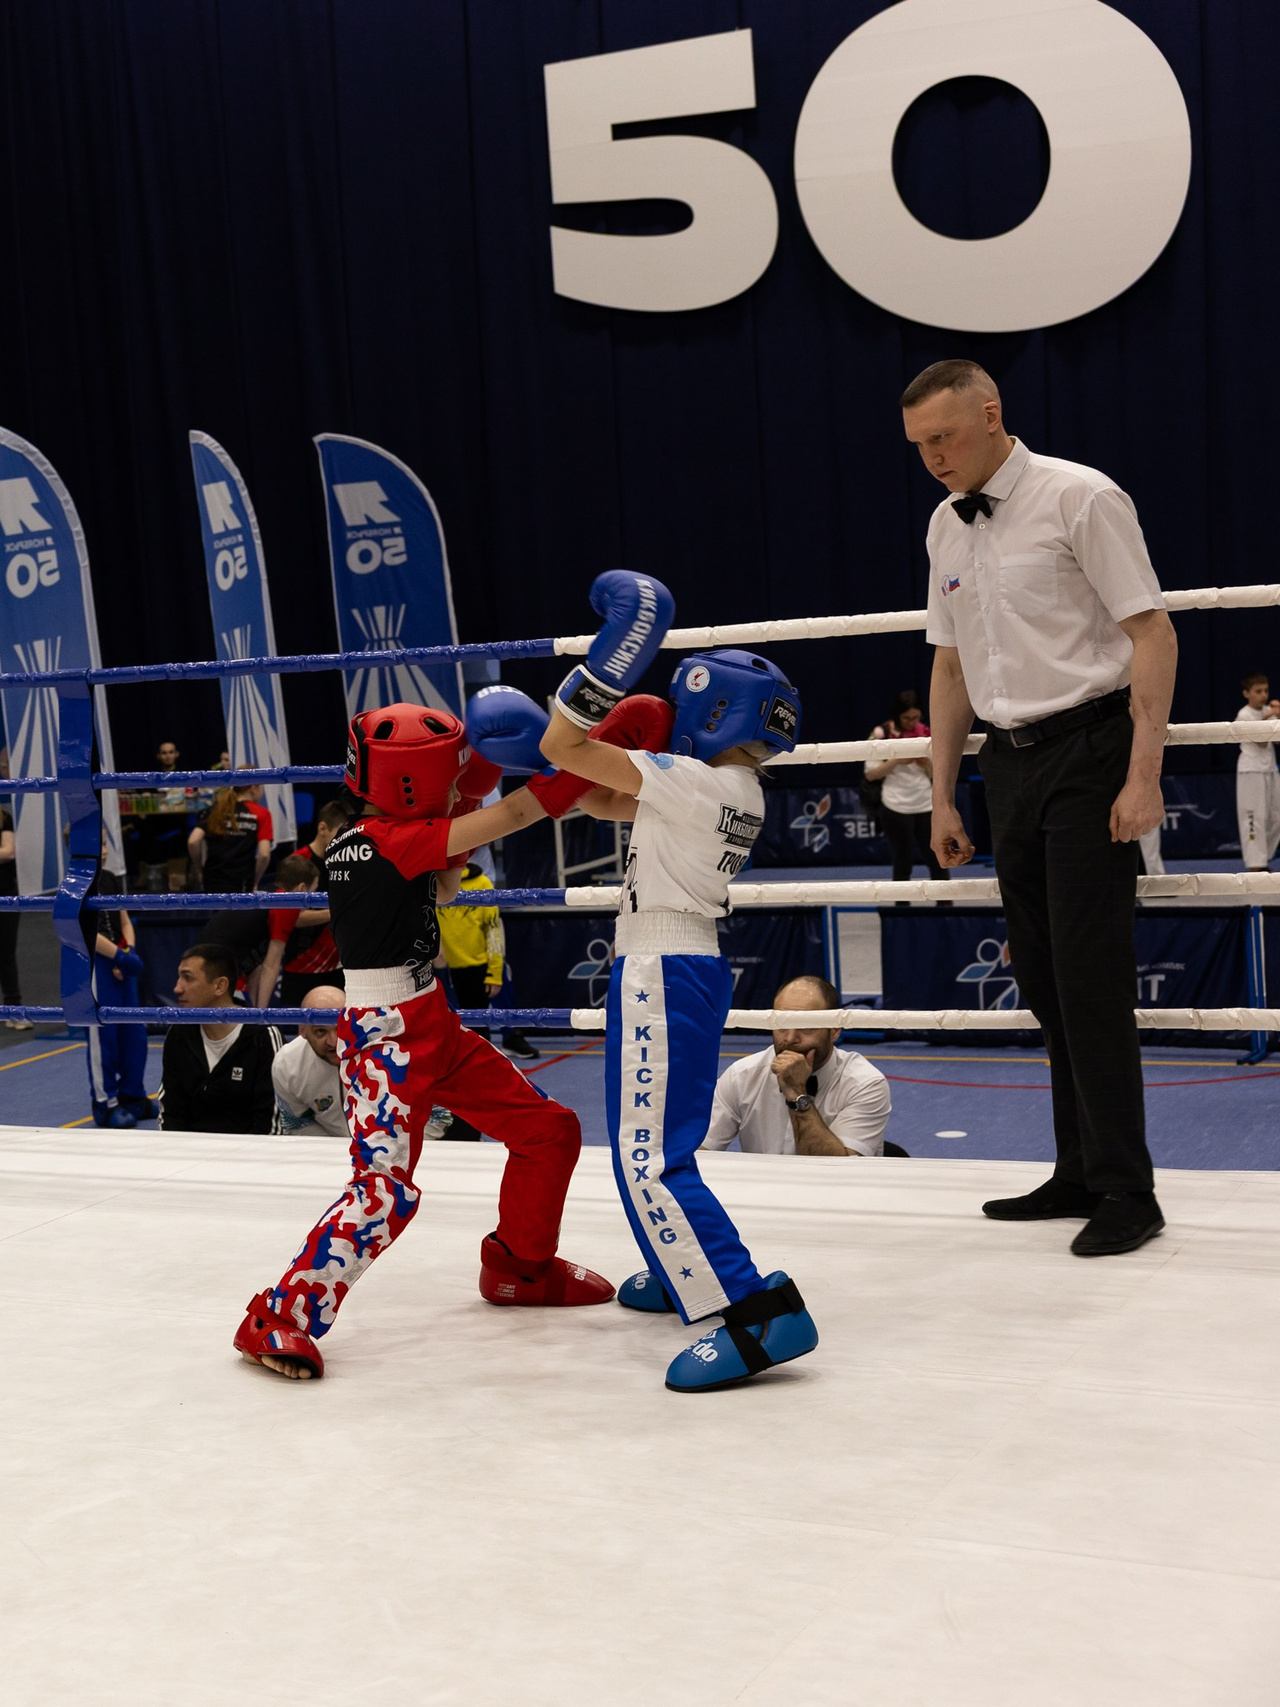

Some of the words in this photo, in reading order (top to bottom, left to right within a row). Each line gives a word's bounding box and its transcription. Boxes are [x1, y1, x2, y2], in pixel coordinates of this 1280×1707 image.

[544, 0, 1192, 333] 50
[603, 578, 658, 680] КИКБОКСИНГ
[634, 1025, 652, 1107] KICK
[631, 1129, 677, 1244] BOXING
